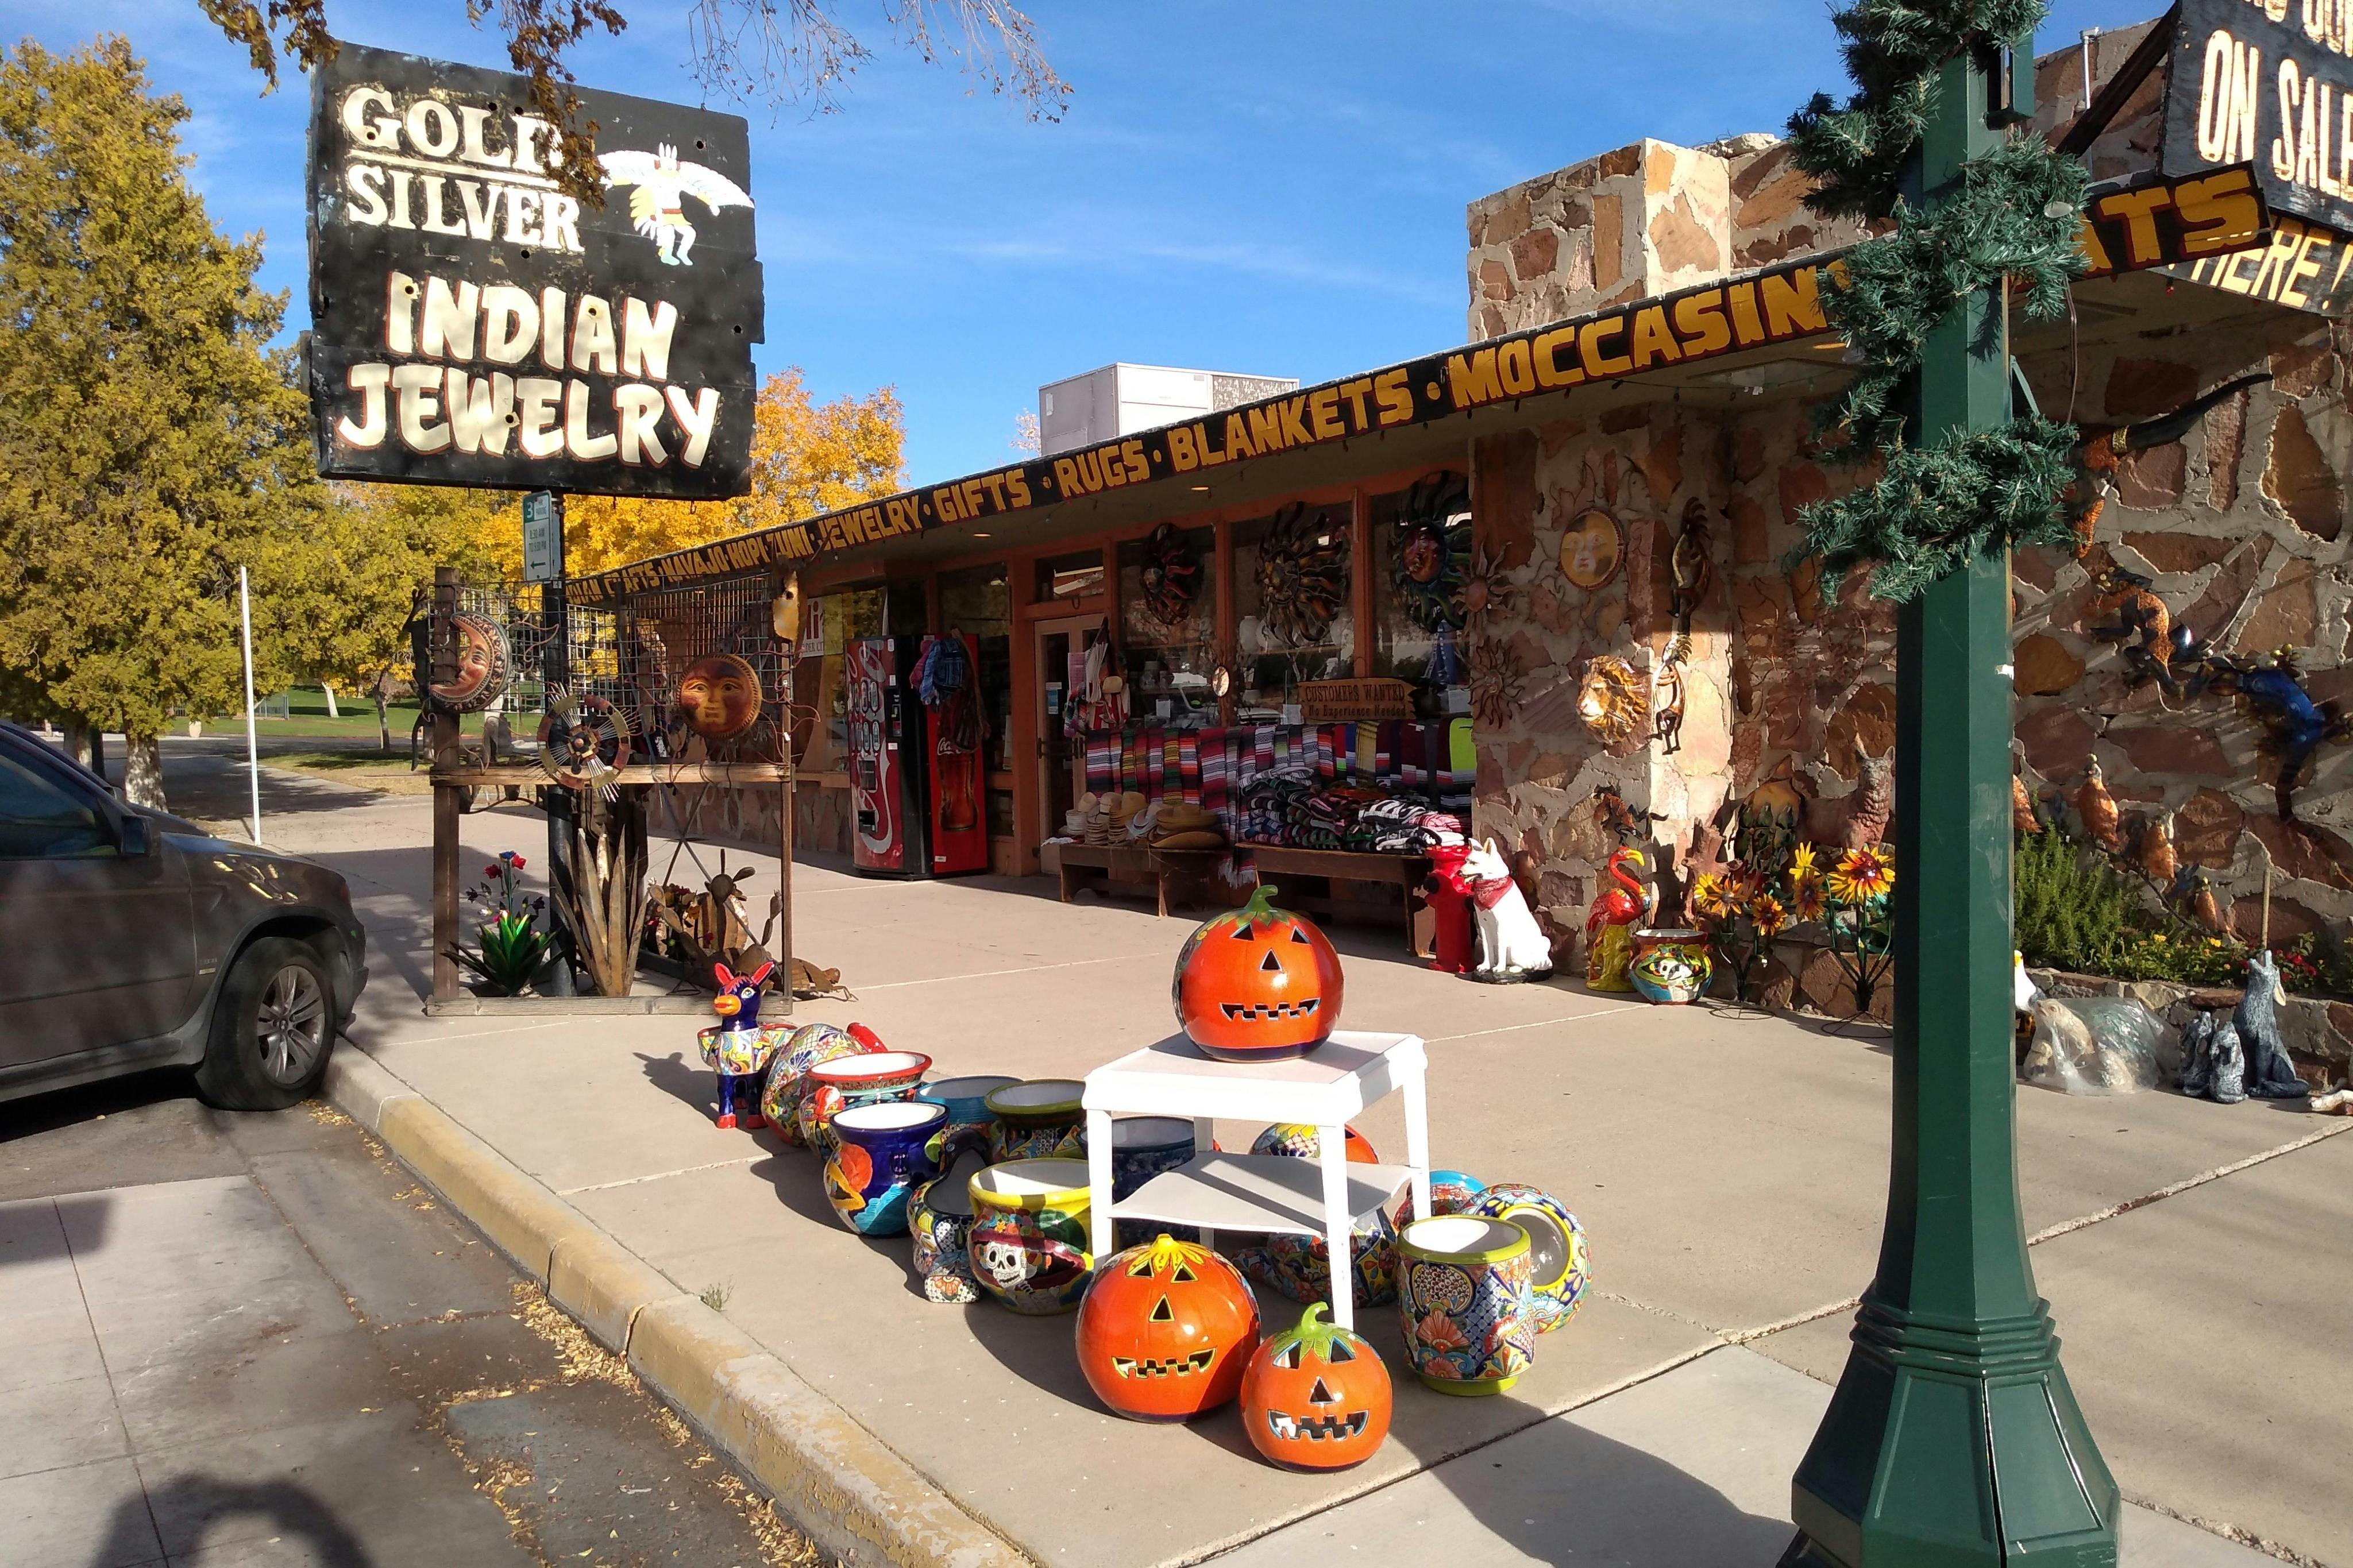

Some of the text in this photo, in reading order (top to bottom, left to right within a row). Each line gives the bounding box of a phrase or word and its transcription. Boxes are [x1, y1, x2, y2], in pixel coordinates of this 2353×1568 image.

[2198, 29, 2259, 165] ON
[347, 165, 585, 253] SILVER
[388, 271, 678, 381] INDIAN
[337, 363, 721, 468] JEWELRY
[662, 545, 730, 582] NAVAJO
[727, 536, 770, 569] HOPI
[766, 525, 814, 559] ZUNI
[817, 495, 923, 551] JEWELRY
[933, 468, 1032, 523] GIFTS
[1054, 439, 1150, 497] RUGS
[1167, 368, 1414, 472] BLANKETS
[1448, 260, 1852, 410] MOCCASIN
[527, 501, 533, 518] 3
[1363, 683, 1405, 702] WANTED
